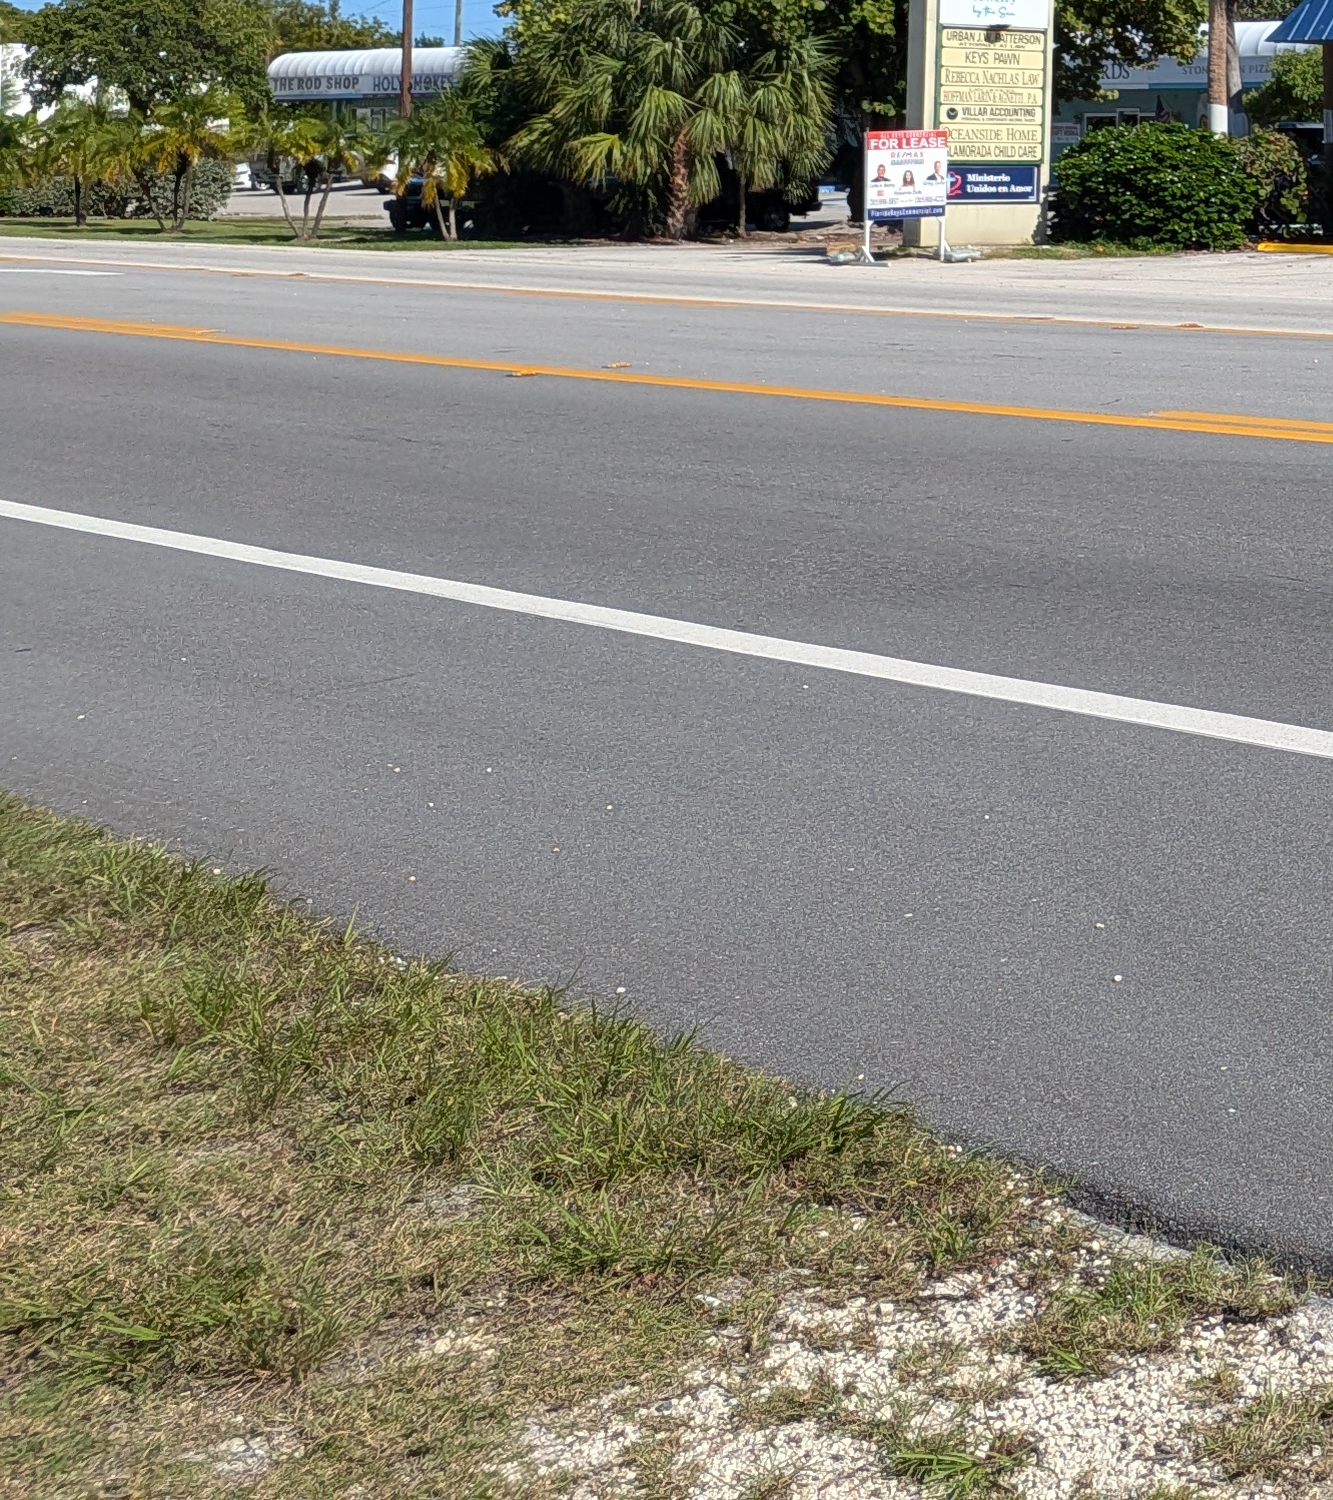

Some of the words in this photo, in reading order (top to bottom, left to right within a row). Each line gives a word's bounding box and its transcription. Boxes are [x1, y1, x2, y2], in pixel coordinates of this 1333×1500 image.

[946, 30, 975, 41] URBAN
[996, 33, 1041, 45] PATTERSON
[965, 51, 989, 64] KEYS
[994, 52, 1020, 65] PAWN
[373, 76, 402, 91] HOLY
[945, 68, 980, 84] REBECCA
[983, 70, 1019, 85] NACHLAS
[1022, 71, 1039, 86] LAW
[273, 78, 294, 91] THE
[297, 77, 322, 90] ROD
[326, 77, 359, 90] SHOP
[962, 107, 987, 116] VILLAR
[990, 108, 1036, 117] ACCOUNTING
[1006, 128, 1038, 141] HOME
[870, 138, 899, 149] FOR
[902, 137, 946, 149] LEASE
[947, 145, 992, 158] LAMORADA
[994, 146, 1016, 158] CHILD
[1018, 145, 1039, 158] CARE
[966, 173, 1011, 182] Ministerio
[966, 184, 997, 193] Unidos
[1009, 184, 1033, 193] Amor
